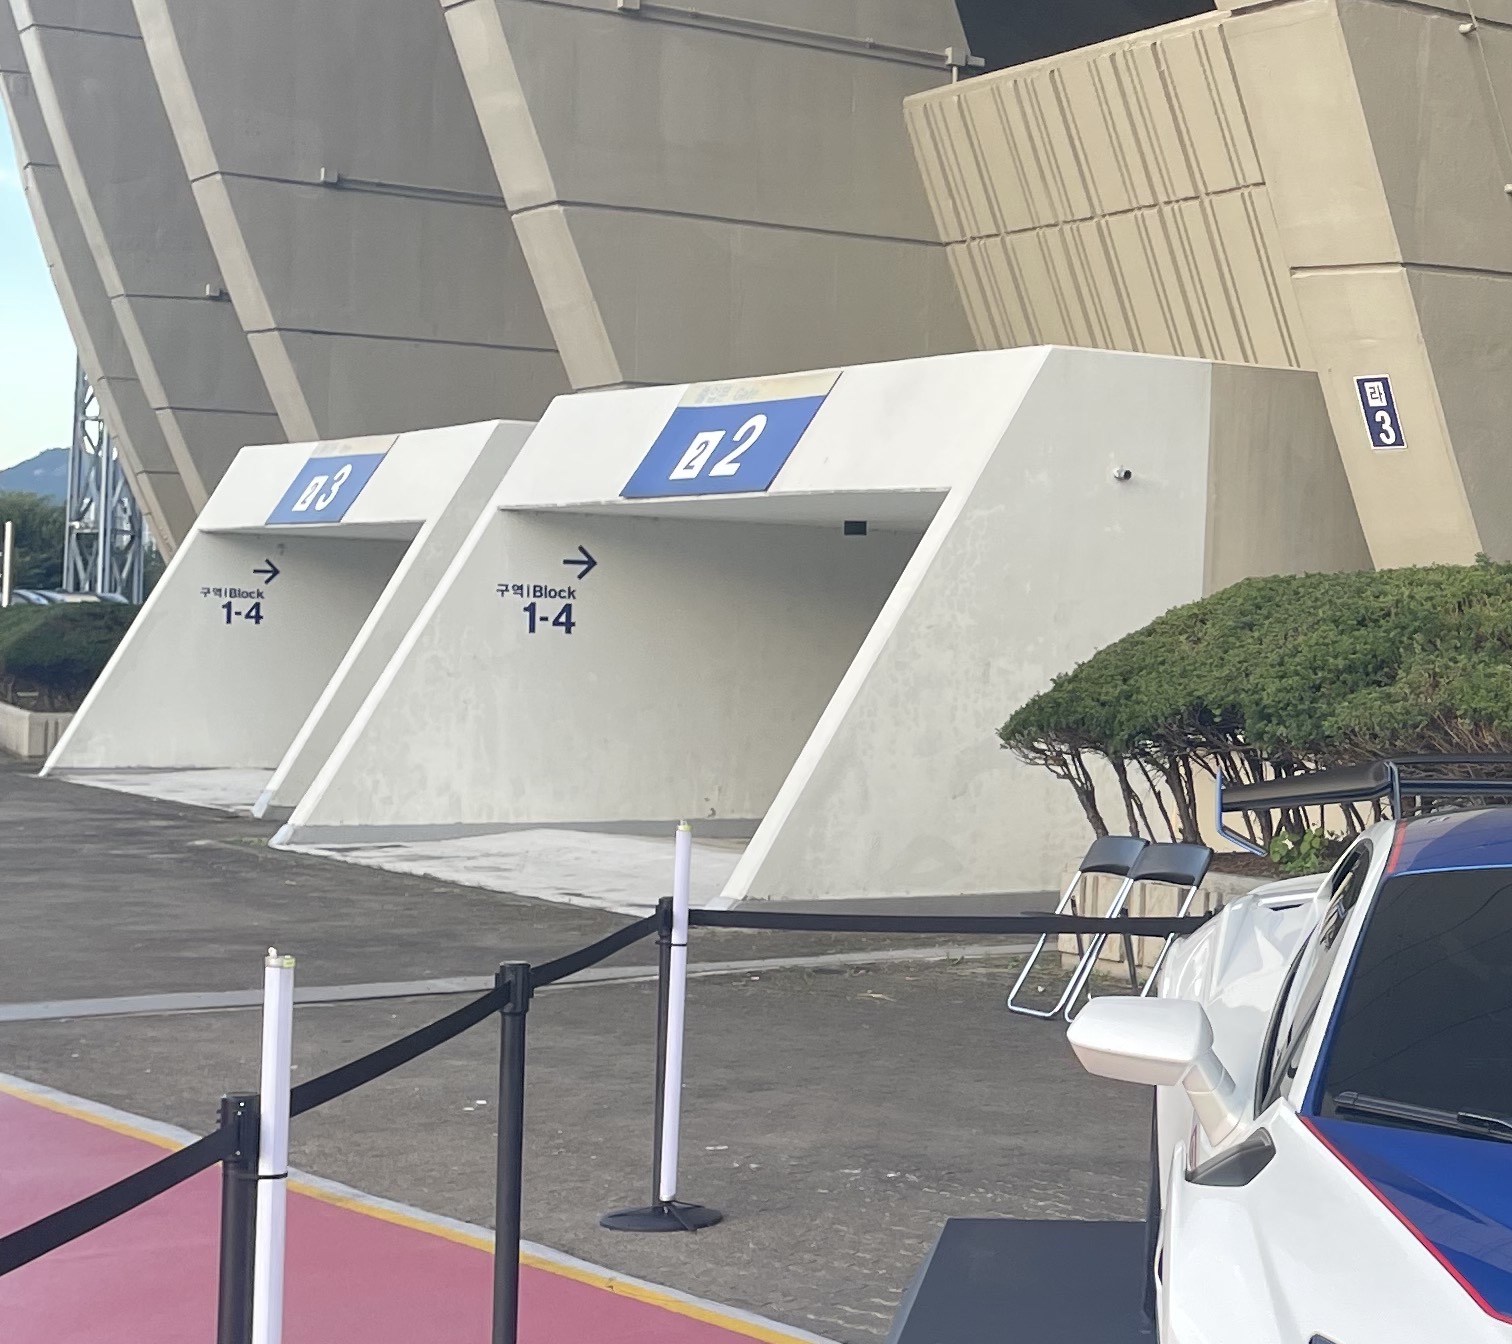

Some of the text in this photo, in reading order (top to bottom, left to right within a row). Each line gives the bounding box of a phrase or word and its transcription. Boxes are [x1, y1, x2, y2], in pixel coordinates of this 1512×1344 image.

[1369, 384, 1384, 404] 라
[1375, 410, 1397, 445] 3
[708, 414, 768, 477] 2
[315, 464, 352, 511] 3
[221, 601, 264, 625] 1-4
[523, 602, 576, 634] 1-4
